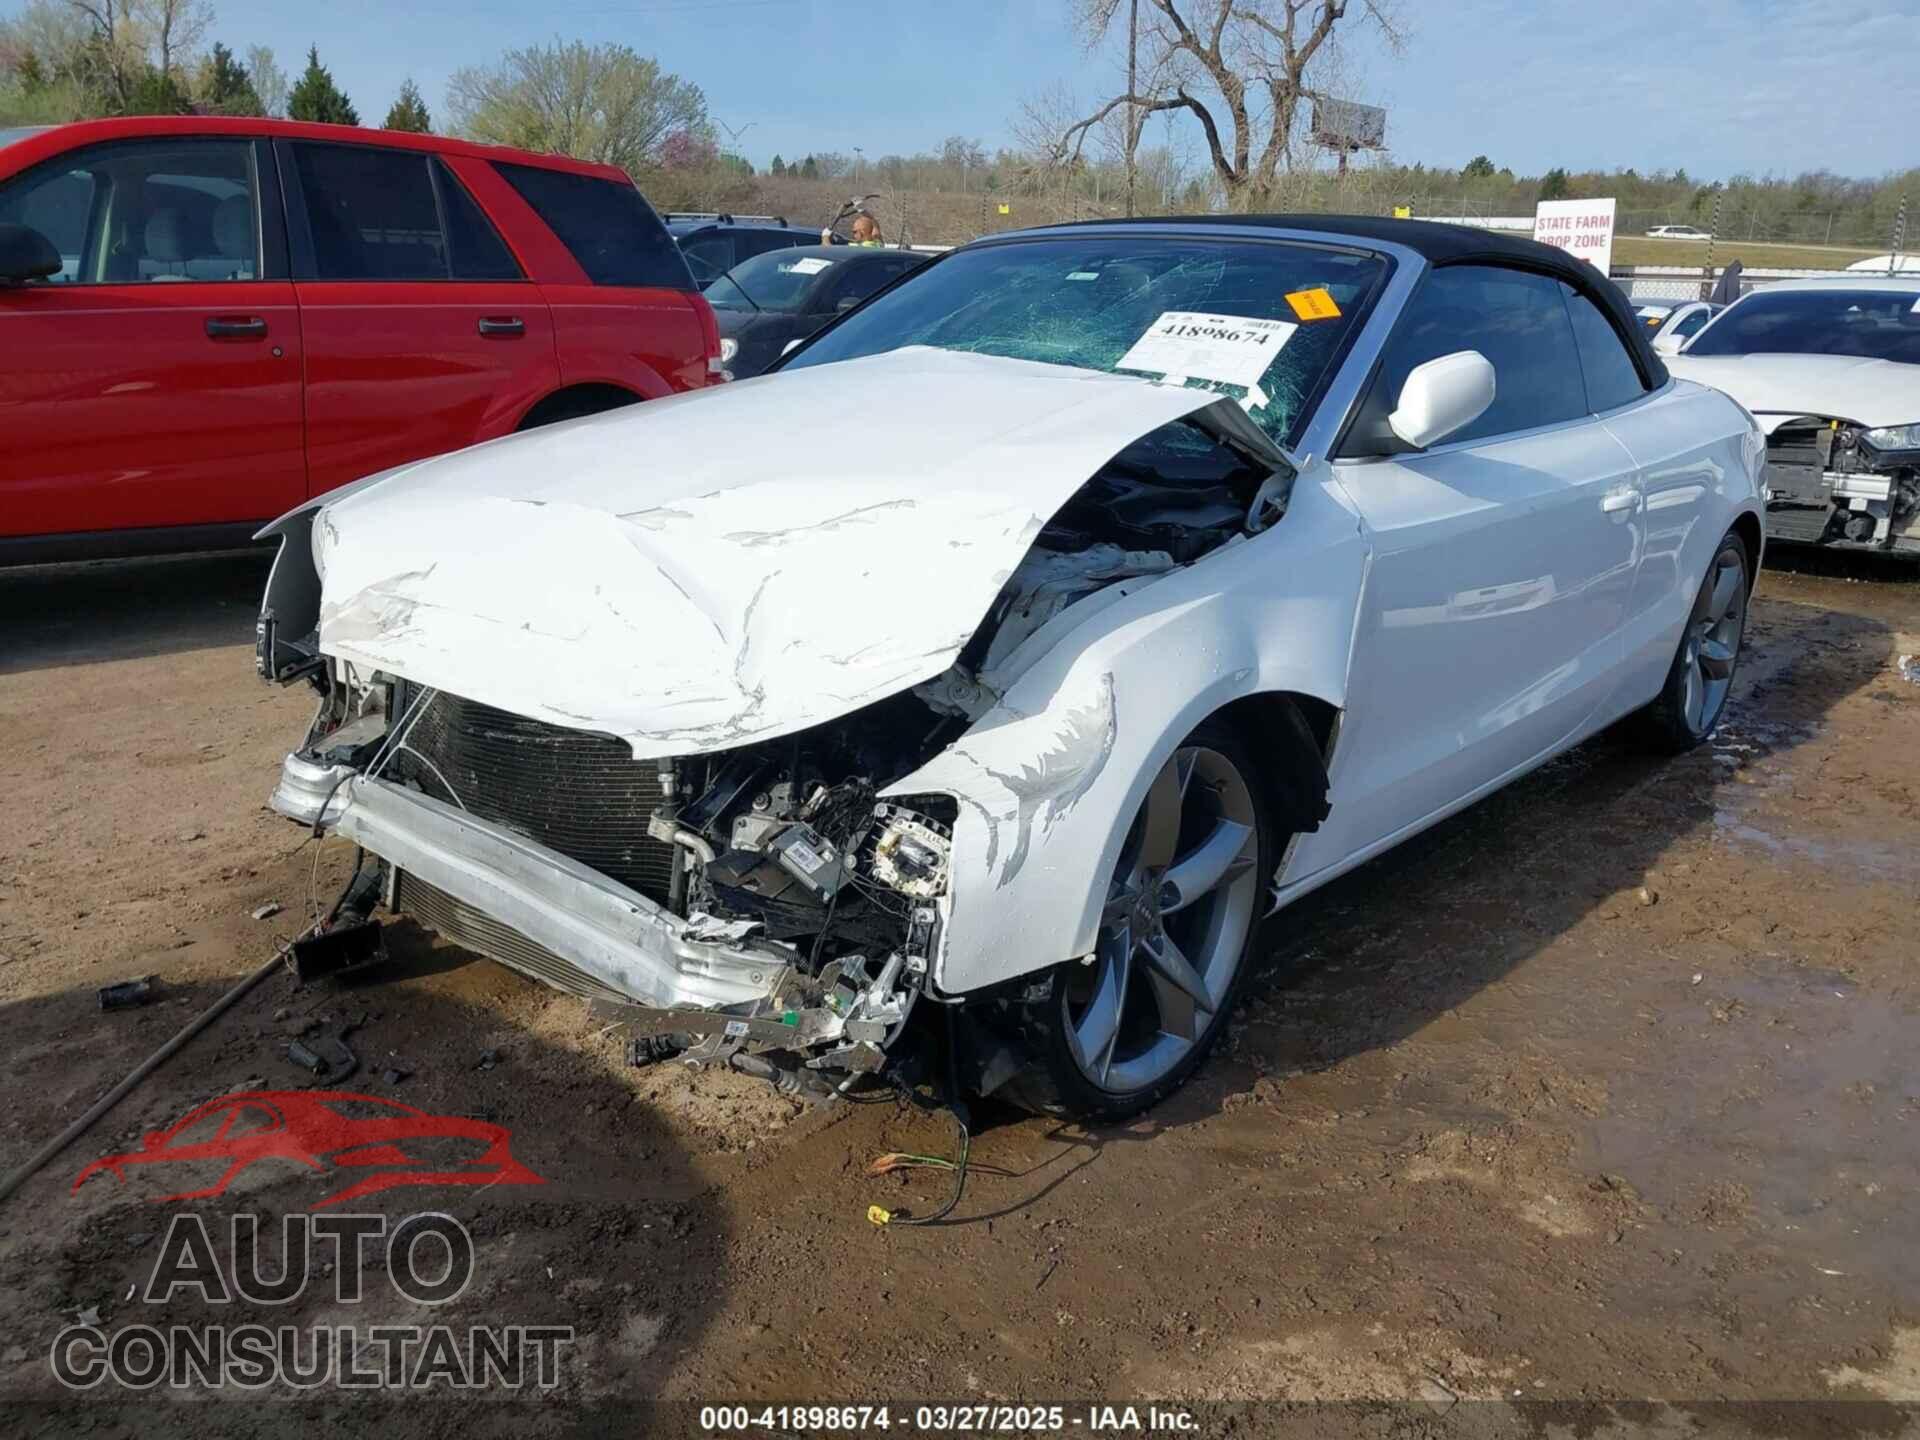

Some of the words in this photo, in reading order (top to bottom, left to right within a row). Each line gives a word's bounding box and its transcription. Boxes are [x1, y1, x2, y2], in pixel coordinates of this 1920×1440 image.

[1538, 217, 1572, 231] STATE
[1576, 215, 1610, 229] FARM
[1574, 234, 1607, 248] ZONE
